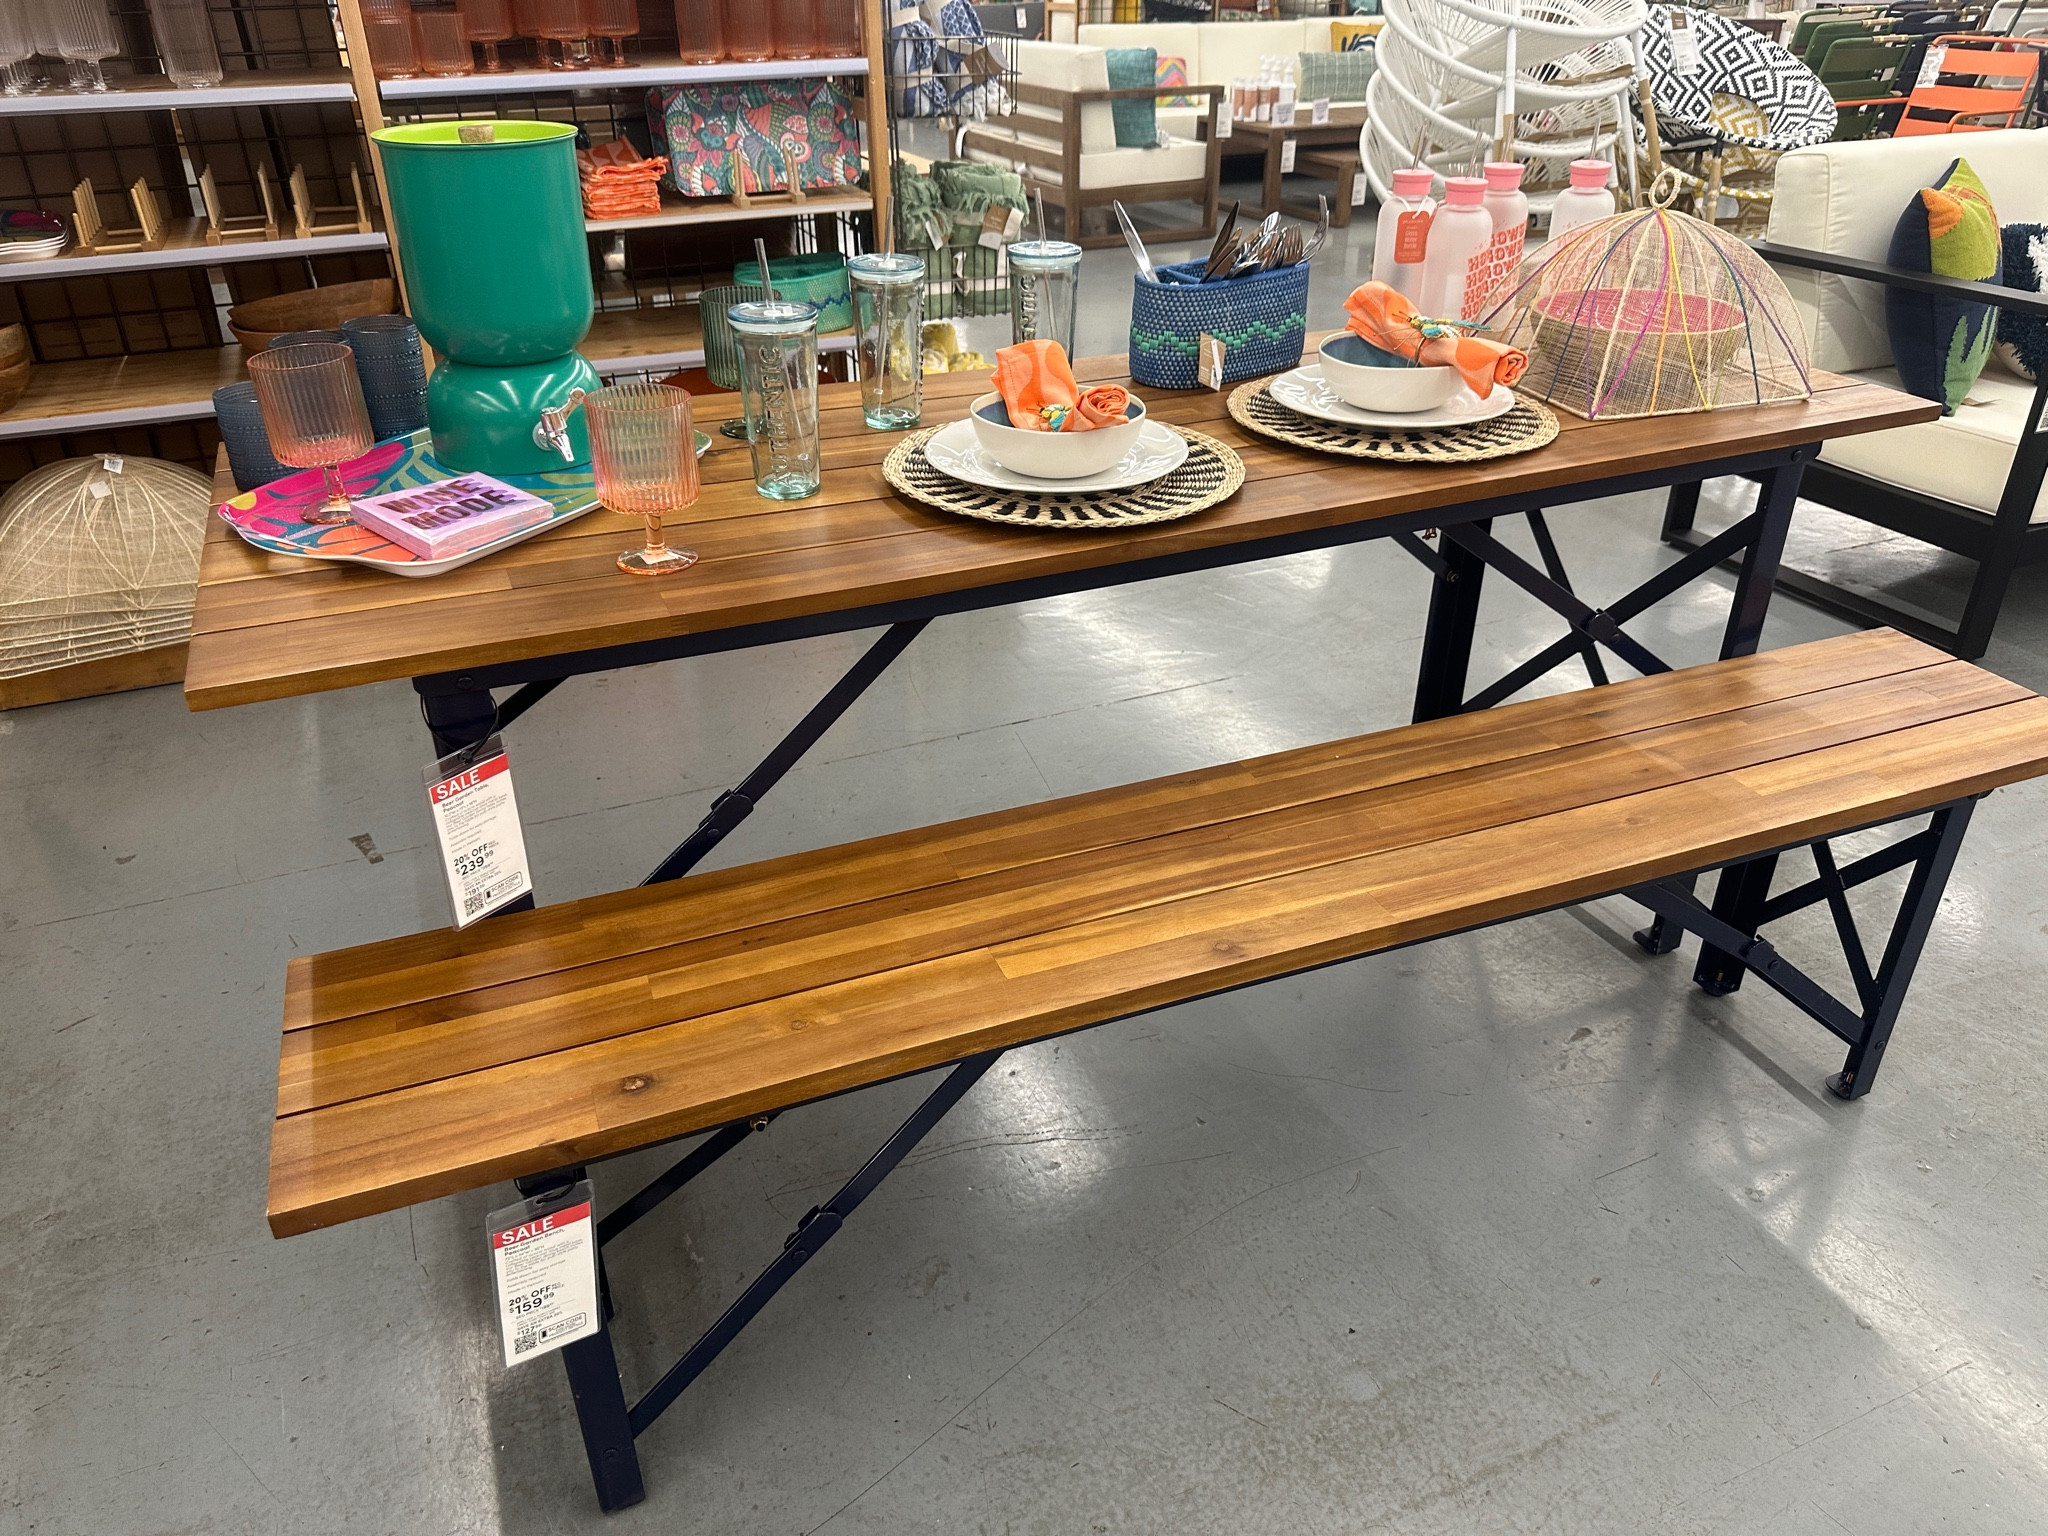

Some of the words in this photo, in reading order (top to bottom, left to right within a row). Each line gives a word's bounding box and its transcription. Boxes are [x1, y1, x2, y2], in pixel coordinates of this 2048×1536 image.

[759, 345, 794, 488] AUTHENTIC
[378, 480, 482, 514] WINE
[402, 490, 514, 530] MODE
[436, 769, 480, 800] SALE
[454, 853, 470, 867] 20%
[471, 843, 487, 857] OFF
[491, 882, 504, 892] SCAN
[502, 1215, 554, 1245] SALE
[505, 1244, 518, 1252] Beer
[520, 1236, 544, 1247] Garden
[505, 1245, 530, 1256] Peacoat
[509, 1294, 529, 1306] 20%
[531, 1284, 551, 1297] OFF
[548, 1322, 564, 1332] SCAN
[566, 1315, 582, 1326] CODE
